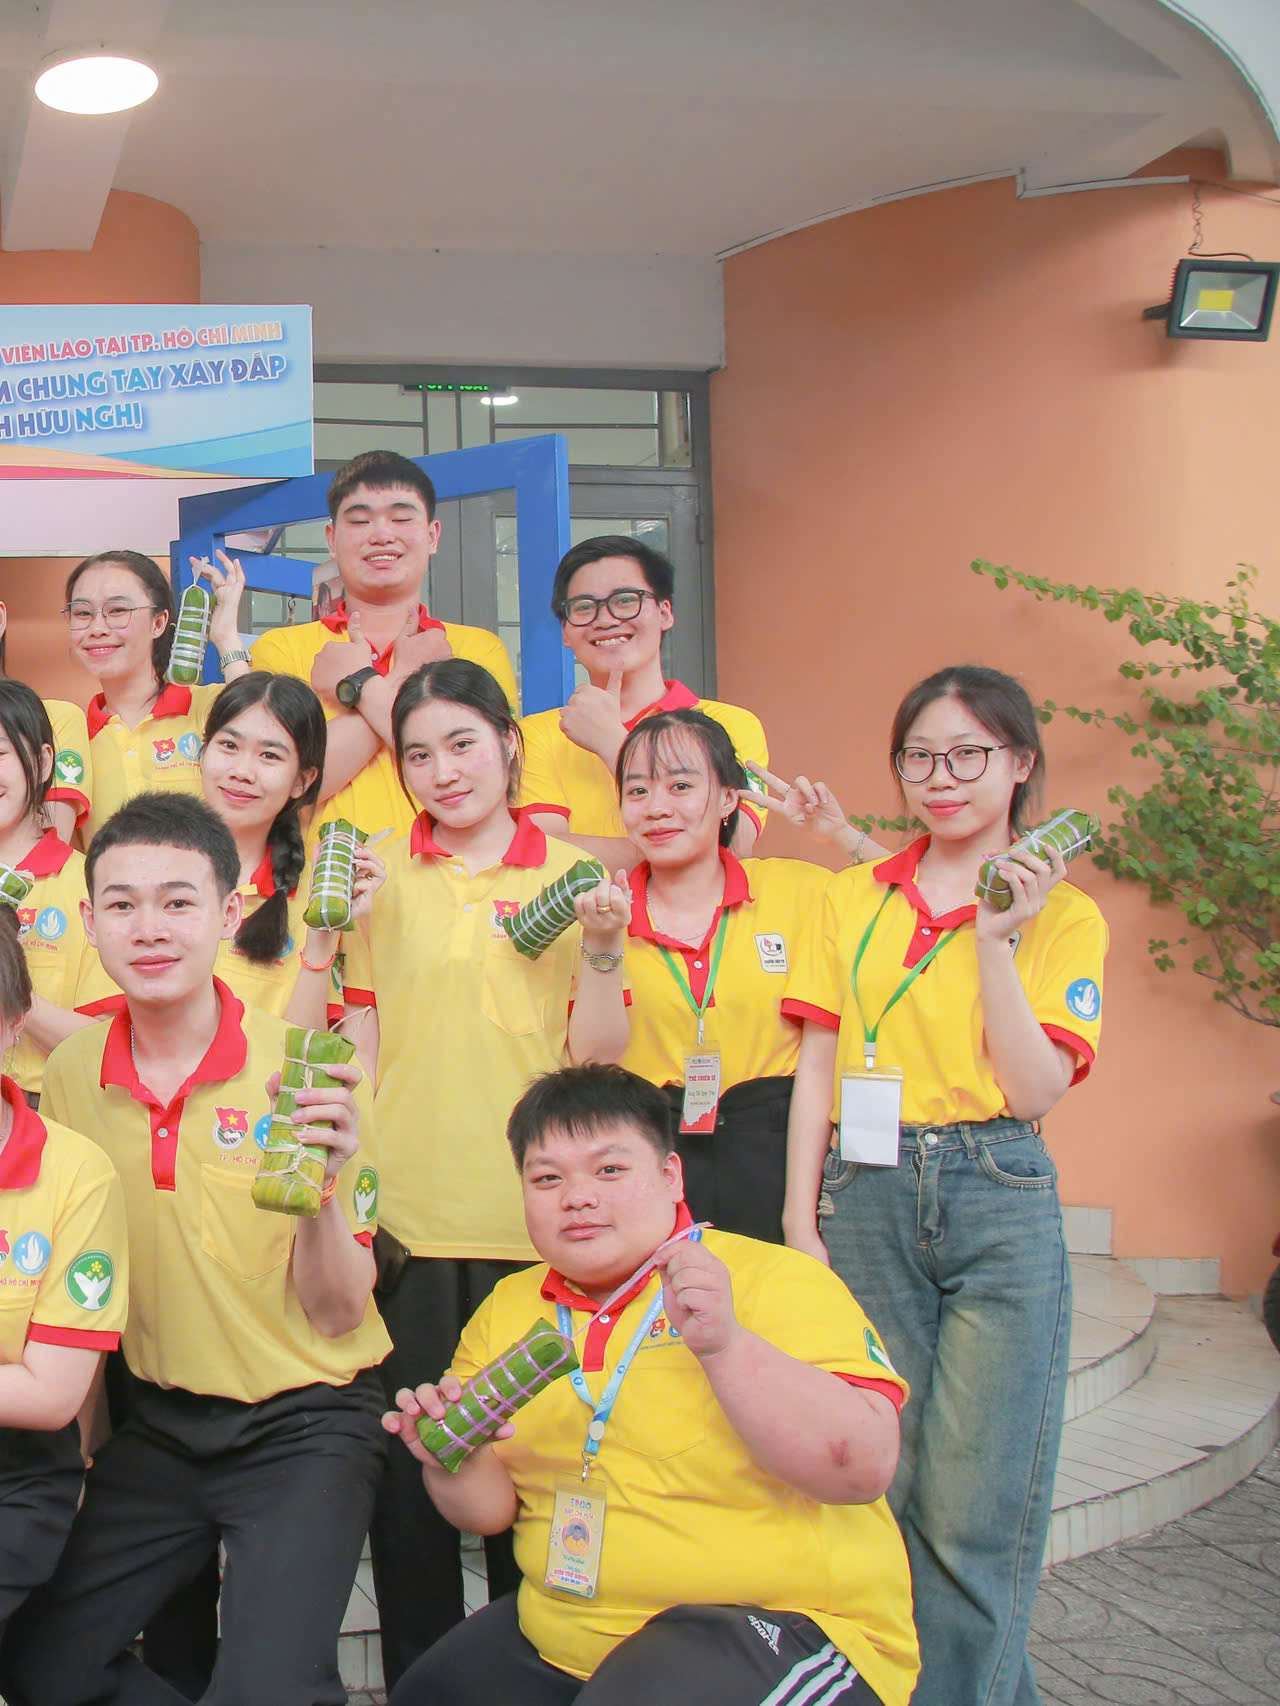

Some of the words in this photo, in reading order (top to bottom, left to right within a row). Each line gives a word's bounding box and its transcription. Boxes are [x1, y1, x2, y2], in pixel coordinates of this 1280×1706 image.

[2, 343, 46, 365] VIÊN
[49, 338, 92, 361] LÀO
[95, 334, 128, 357] TẠI
[130, 333, 160, 353] TP.
[163, 327, 194, 349] HỒ
[197, 324, 228, 346] CHÍ
[230, 320, 283, 343] MINH
[17, 370, 107, 401] CHUNG
[111, 364, 163, 393] TAY
[169, 358, 224, 388] XÂY
[230, 352, 287, 382] ĐẮP
[16, 407, 69, 437] HỮU
[74, 401, 143, 432] NGHỊ
[746, 1615, 780, 1656] sports
